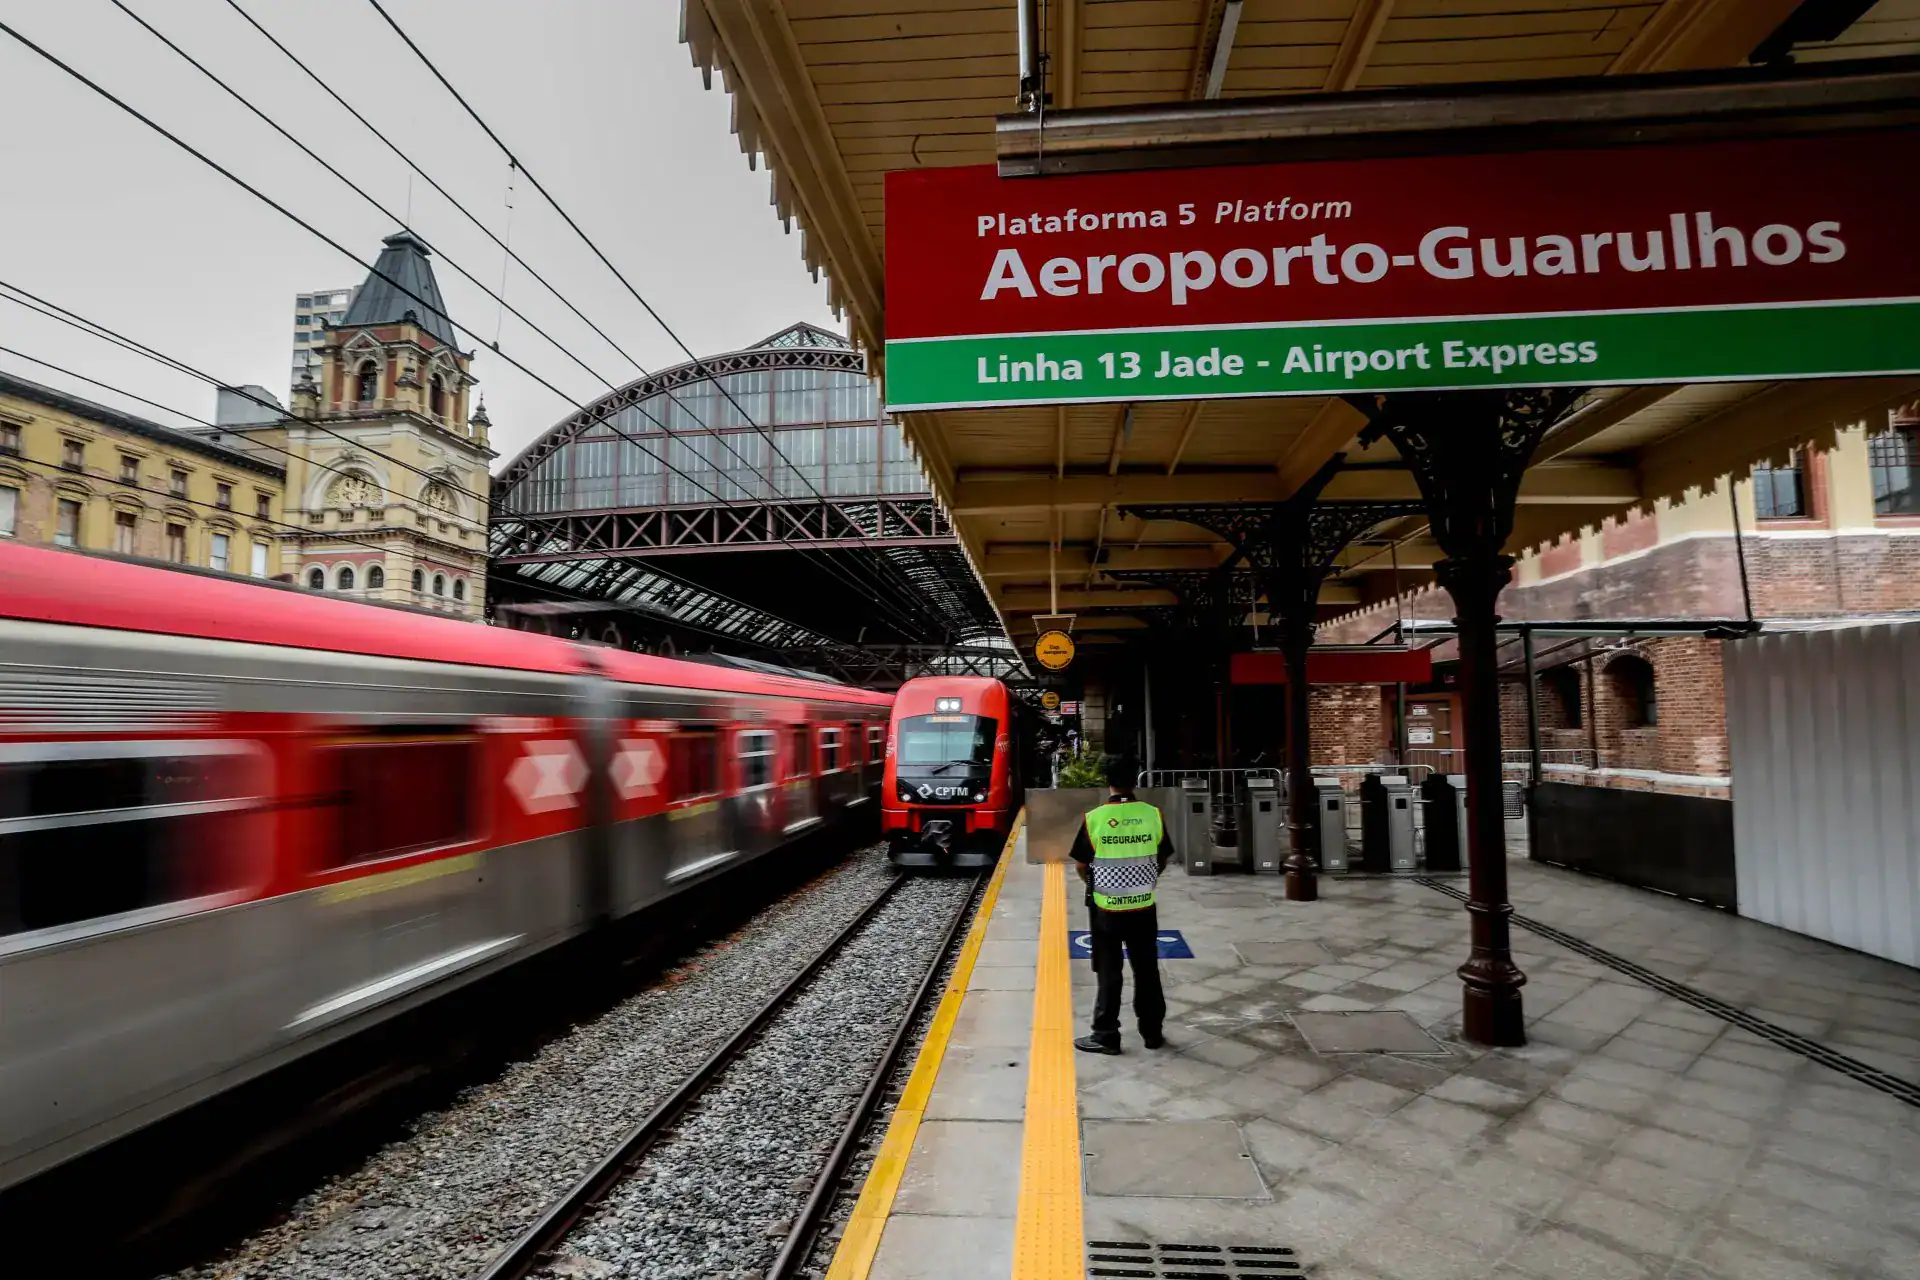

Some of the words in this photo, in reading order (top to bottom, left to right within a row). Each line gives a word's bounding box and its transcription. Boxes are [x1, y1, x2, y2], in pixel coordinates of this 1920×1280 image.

[977, 208, 1167, 237] Plataforma
[1179, 203, 1196, 226] 5
[1215, 197, 1353, 224] Platform
[980, 211, 1846, 306] Aeroporto-Guarulhos
[977, 352, 1083, 384] Linha
[1098, 351, 1141, 379] 13
[1154, 347, 1244, 378] Jade
[1282, 342, 1431, 379] Airport
[1442, 340, 1598, 374] Express
[935, 786, 969, 796] CPTM
[1101, 834, 1152, 845] SEGURANÇA
